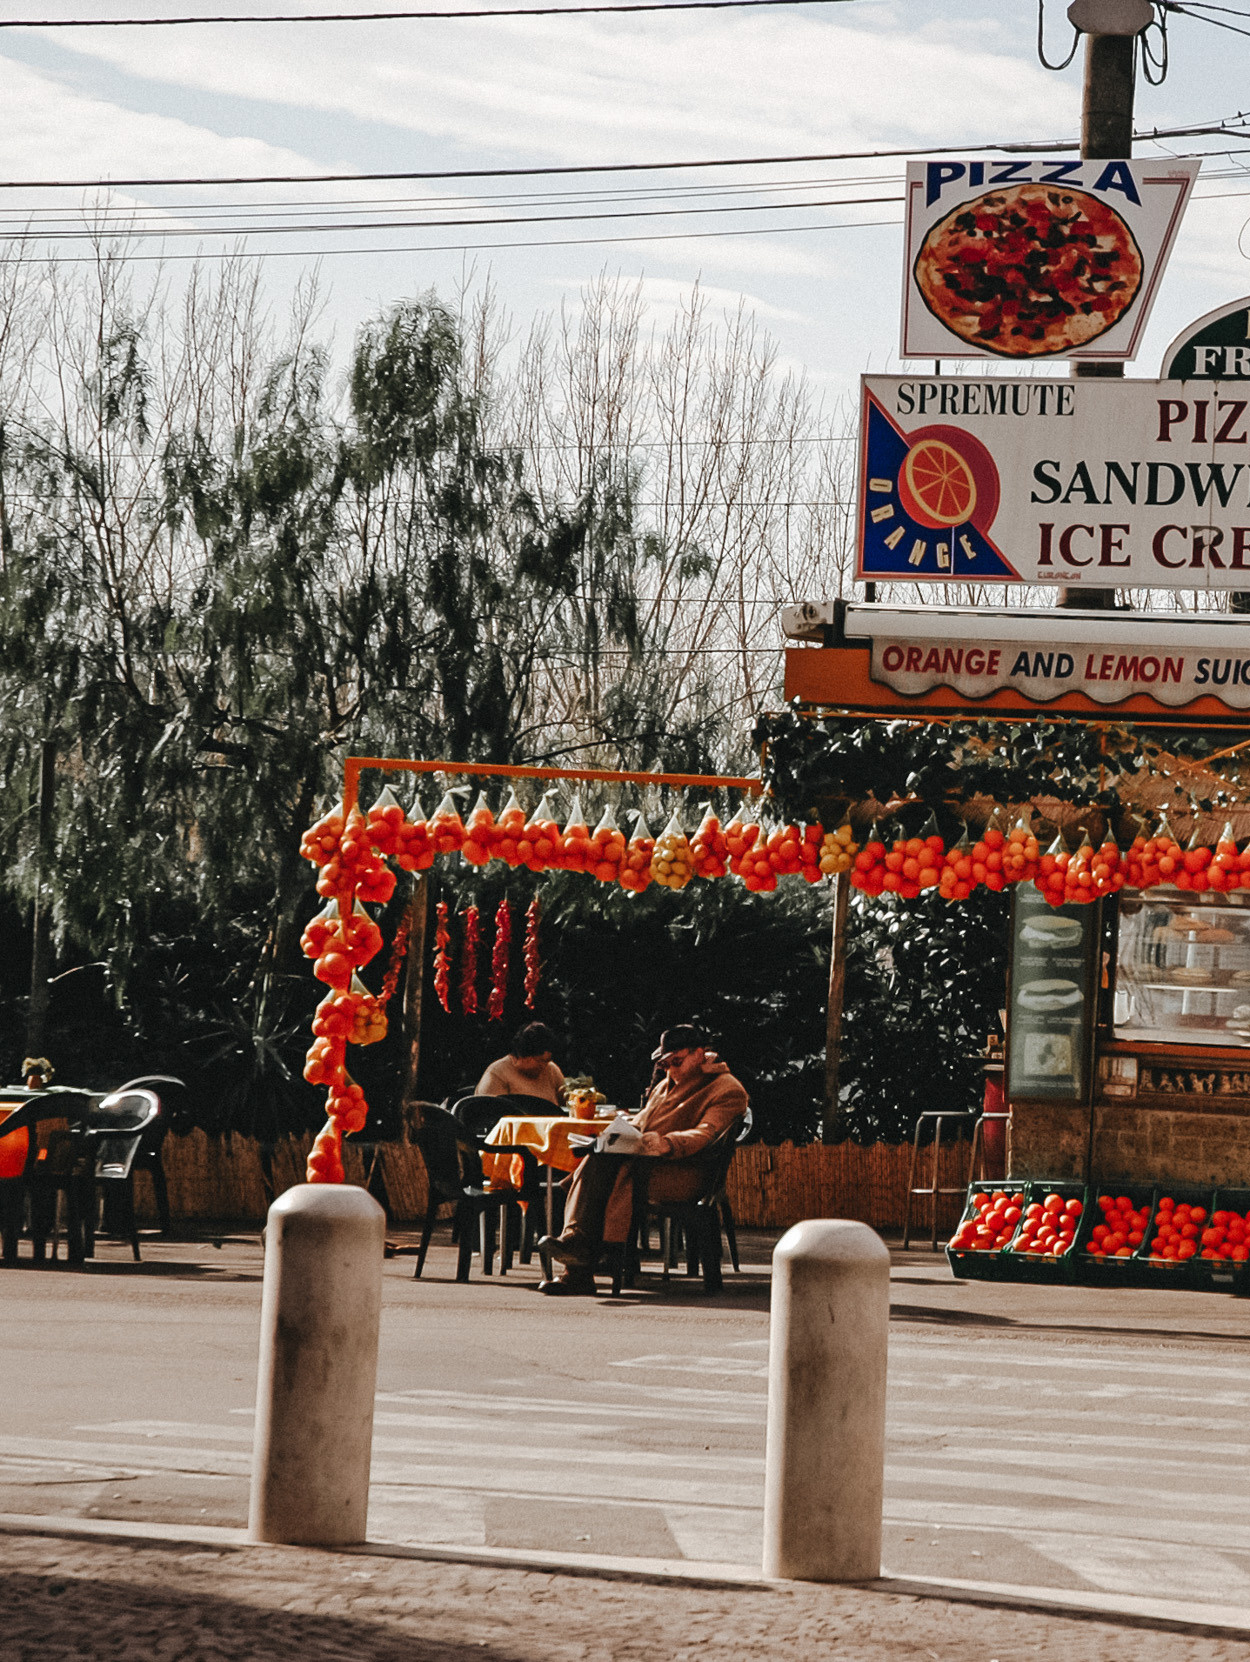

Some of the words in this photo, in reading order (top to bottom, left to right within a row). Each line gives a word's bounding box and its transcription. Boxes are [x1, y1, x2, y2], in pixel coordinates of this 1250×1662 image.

[926, 161, 1142, 208] PIZZA
[897, 382, 1075, 416] SPREMUTE
[869, 477, 977, 569] ORANGE
[1037, 523, 1132, 567] ICE
[882, 645, 1001, 676] ORANGE
[1010, 651, 1074, 678] AND
[1084, 654, 1185, 683] LEMON
